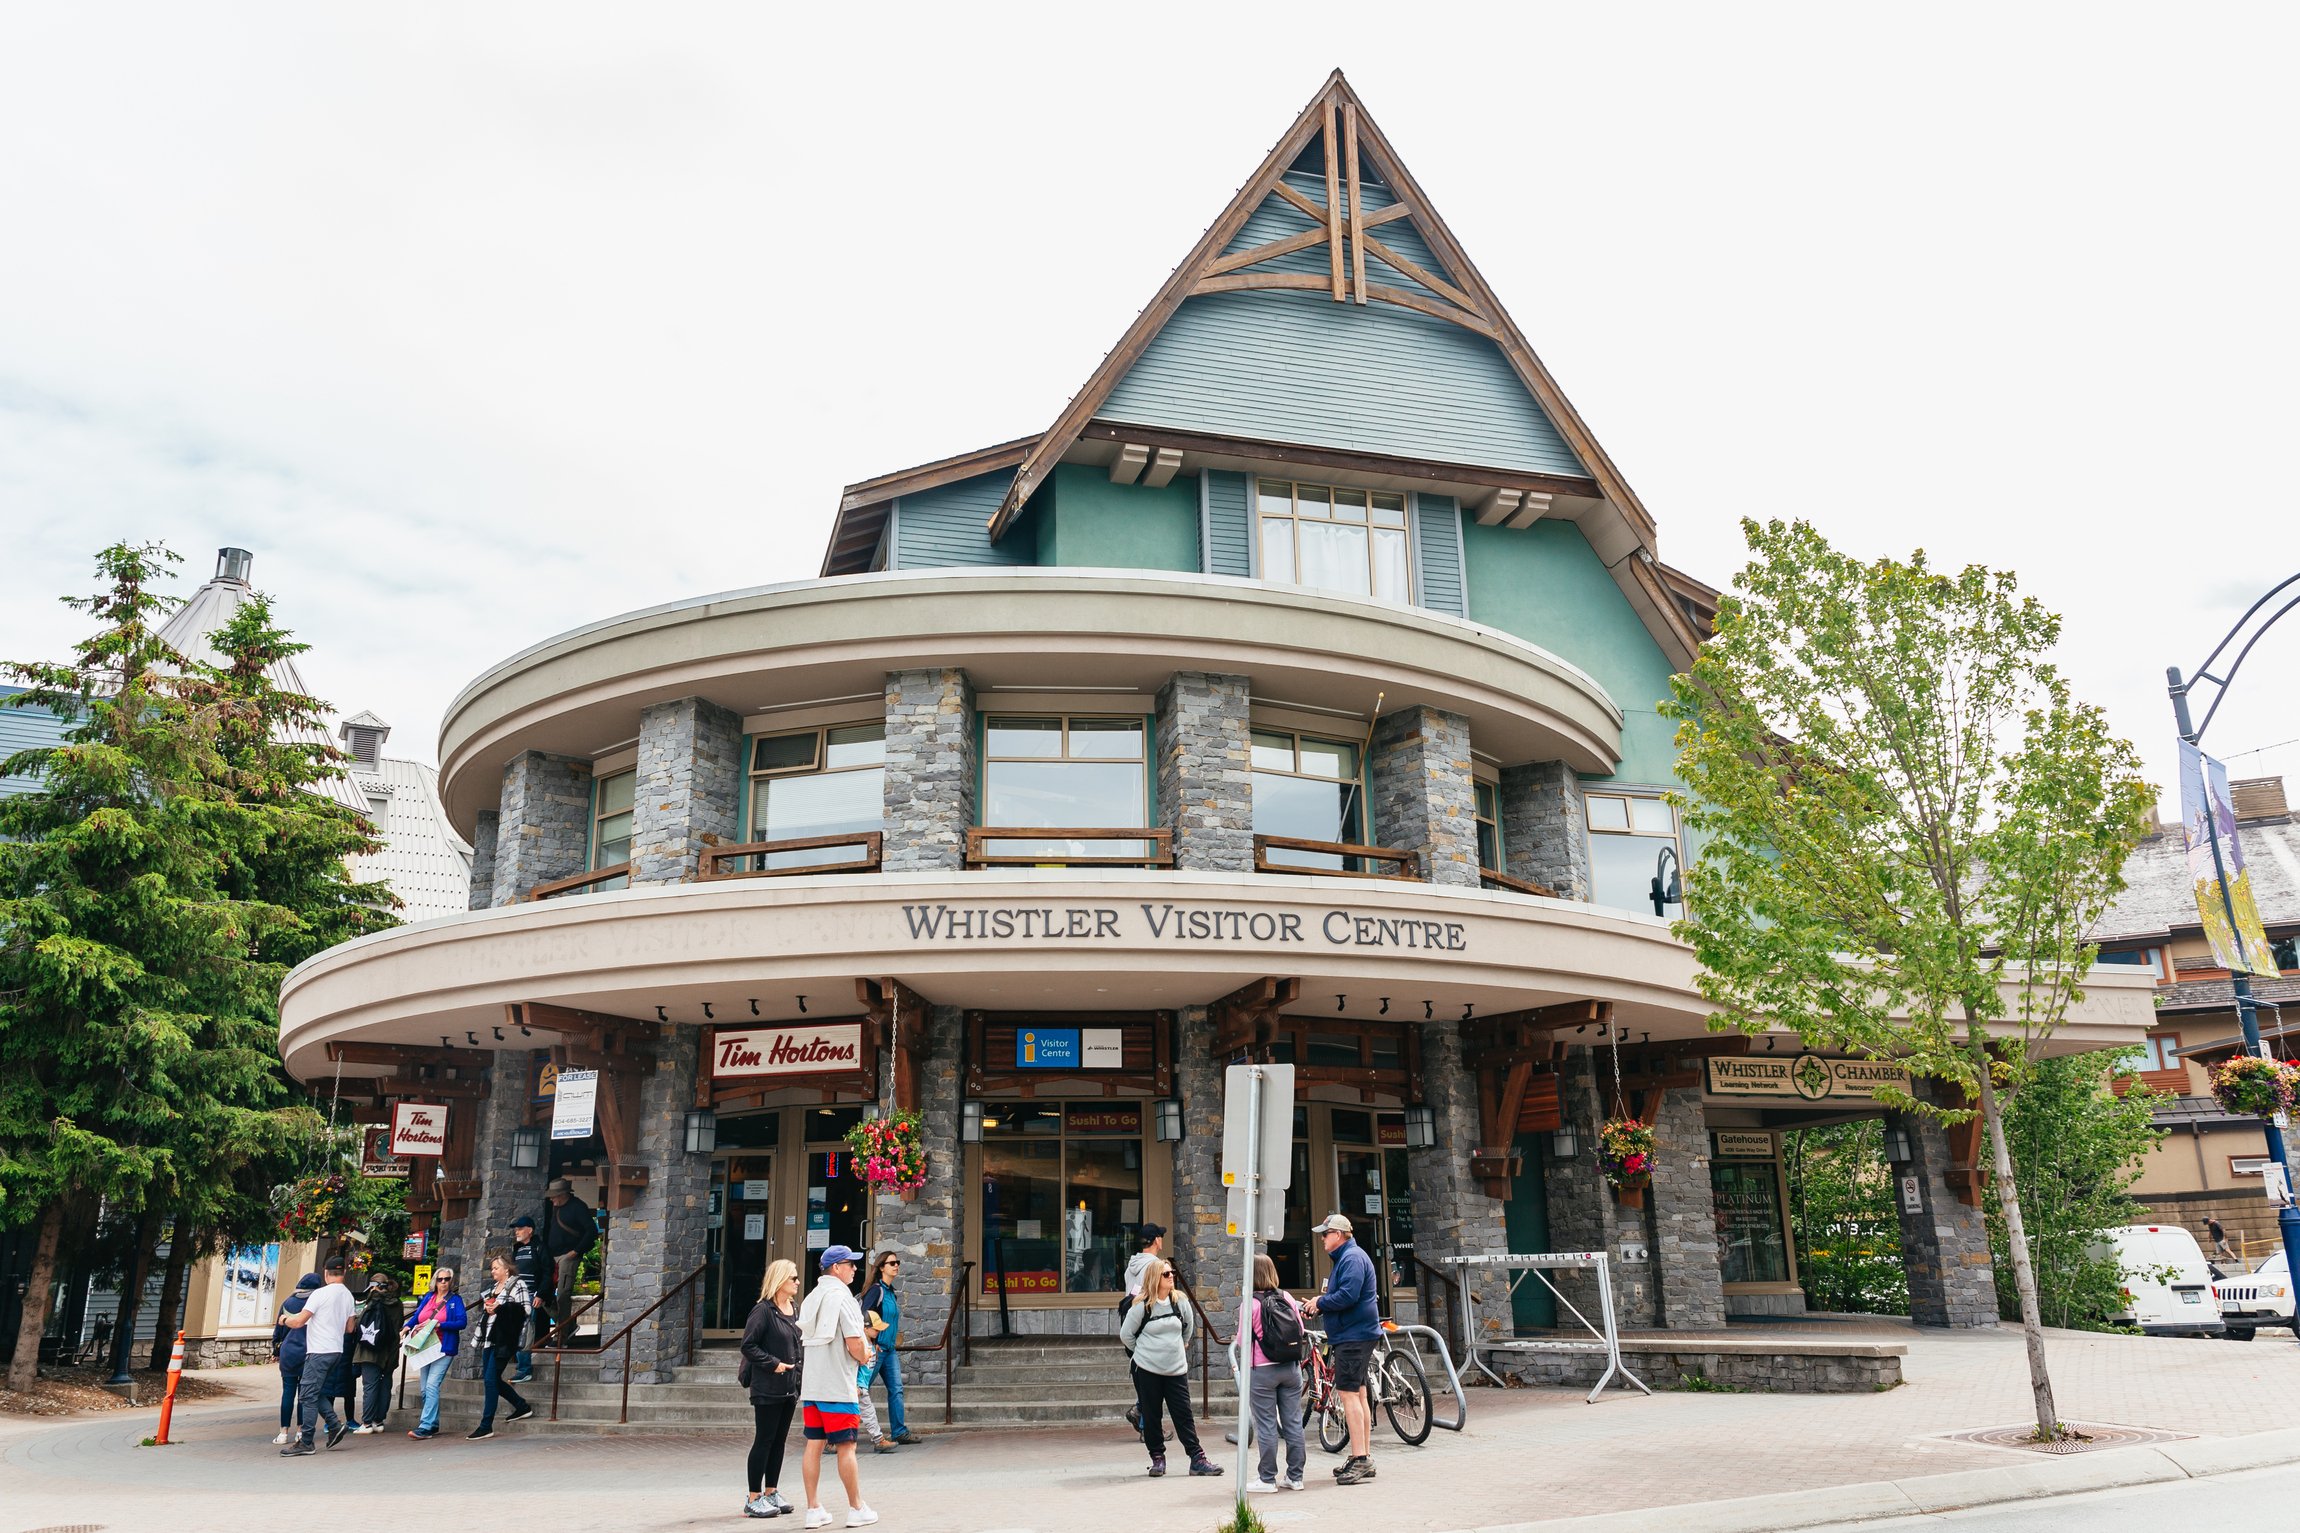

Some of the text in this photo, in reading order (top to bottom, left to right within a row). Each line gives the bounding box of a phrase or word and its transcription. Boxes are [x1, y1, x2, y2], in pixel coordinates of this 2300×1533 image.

[902, 905, 1121, 940] WHISTLER
[1141, 904, 1304, 942] VISITOR
[1322, 911, 1467, 951] CENTRE
[1041, 1039, 1068, 1048] Visitor
[719, 1034, 855, 1068] Tim Hortons
[1041, 1049, 1070, 1057] Centre
[574, 1072, 596, 1080] LEASE
[1713, 1060, 1906, 1081] WHISTLER CHAMBER
[1720, 1081, 1749, 1089] Learning
[1751, 1081, 1779, 1089] Network
[411, 1111, 433, 1126] Tim
[1069, 1115, 1137, 1126] Sushi To Go
[396, 1127, 442, 1144] Hortons
[1380, 1129, 1406, 1140] Sushi
[1720, 1134, 1769, 1144] Gatehouse
[1716, 1194, 1772, 1204] PLATINUM
[986, 1276, 1057, 1289] Suhi To Go
